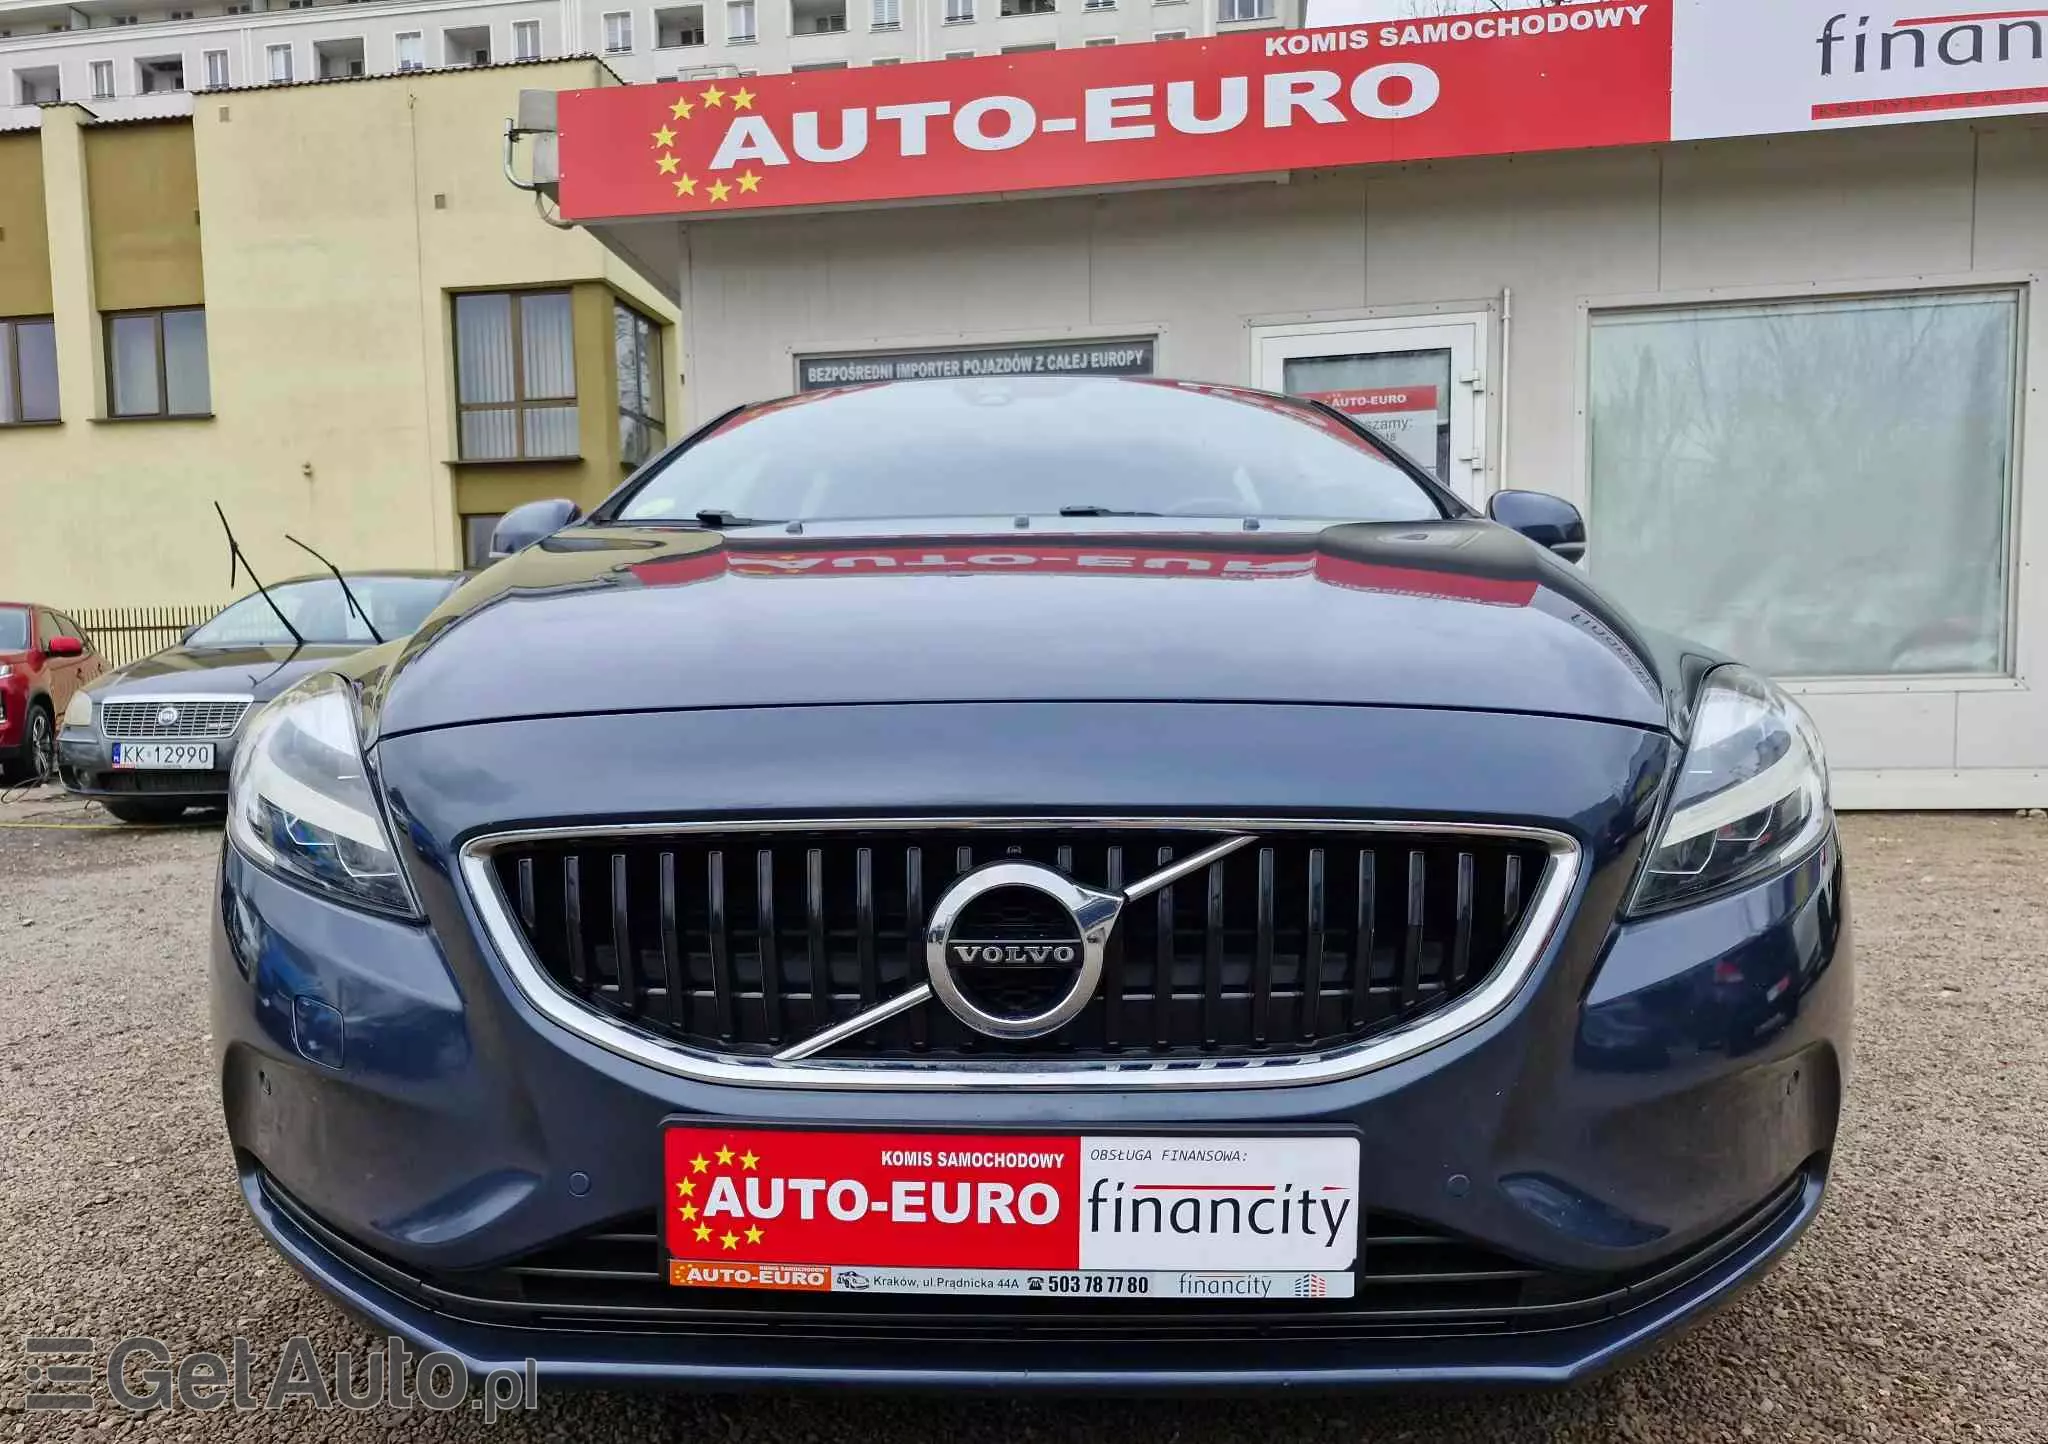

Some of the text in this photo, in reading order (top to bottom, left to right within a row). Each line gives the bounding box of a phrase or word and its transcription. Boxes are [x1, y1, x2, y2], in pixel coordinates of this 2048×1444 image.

[1265, 4, 1649, 57] KOMIS SAMOCHODOWY
[708, 61, 1441, 170] AUTO-EURO
[808, 349, 1144, 383] BEZPOŚREDNI IMPORTER POJAZDÓW Z CAŁEJ EUROPY
[1331, 394, 1407, 407] AUTO-EURO
[124, 745, 145, 763] KK
[154, 746, 209, 764] 12990
[953, 946, 1075, 963] VOLVO
[881, 1150, 1065, 1169] KOMIS SAMOCHODOWY
[1090, 1149, 1248, 1163] OBSŁUGA FINANSOWA:
[702, 1176, 1061, 1226] AUTO-EURO
[1087, 1177, 1351, 1248] financity
[686, 1267, 825, 1286] AUTO-EURO
[997, 1278, 1020, 1289] 44A
[1048, 1275, 1080, 1294] 503
[1084, 1275, 1103, 1294] 78
[1107, 1276, 1124, 1294] 77
[1127, 1276, 1149, 1294] 80
[1178, 1272, 1272, 1298] financity
